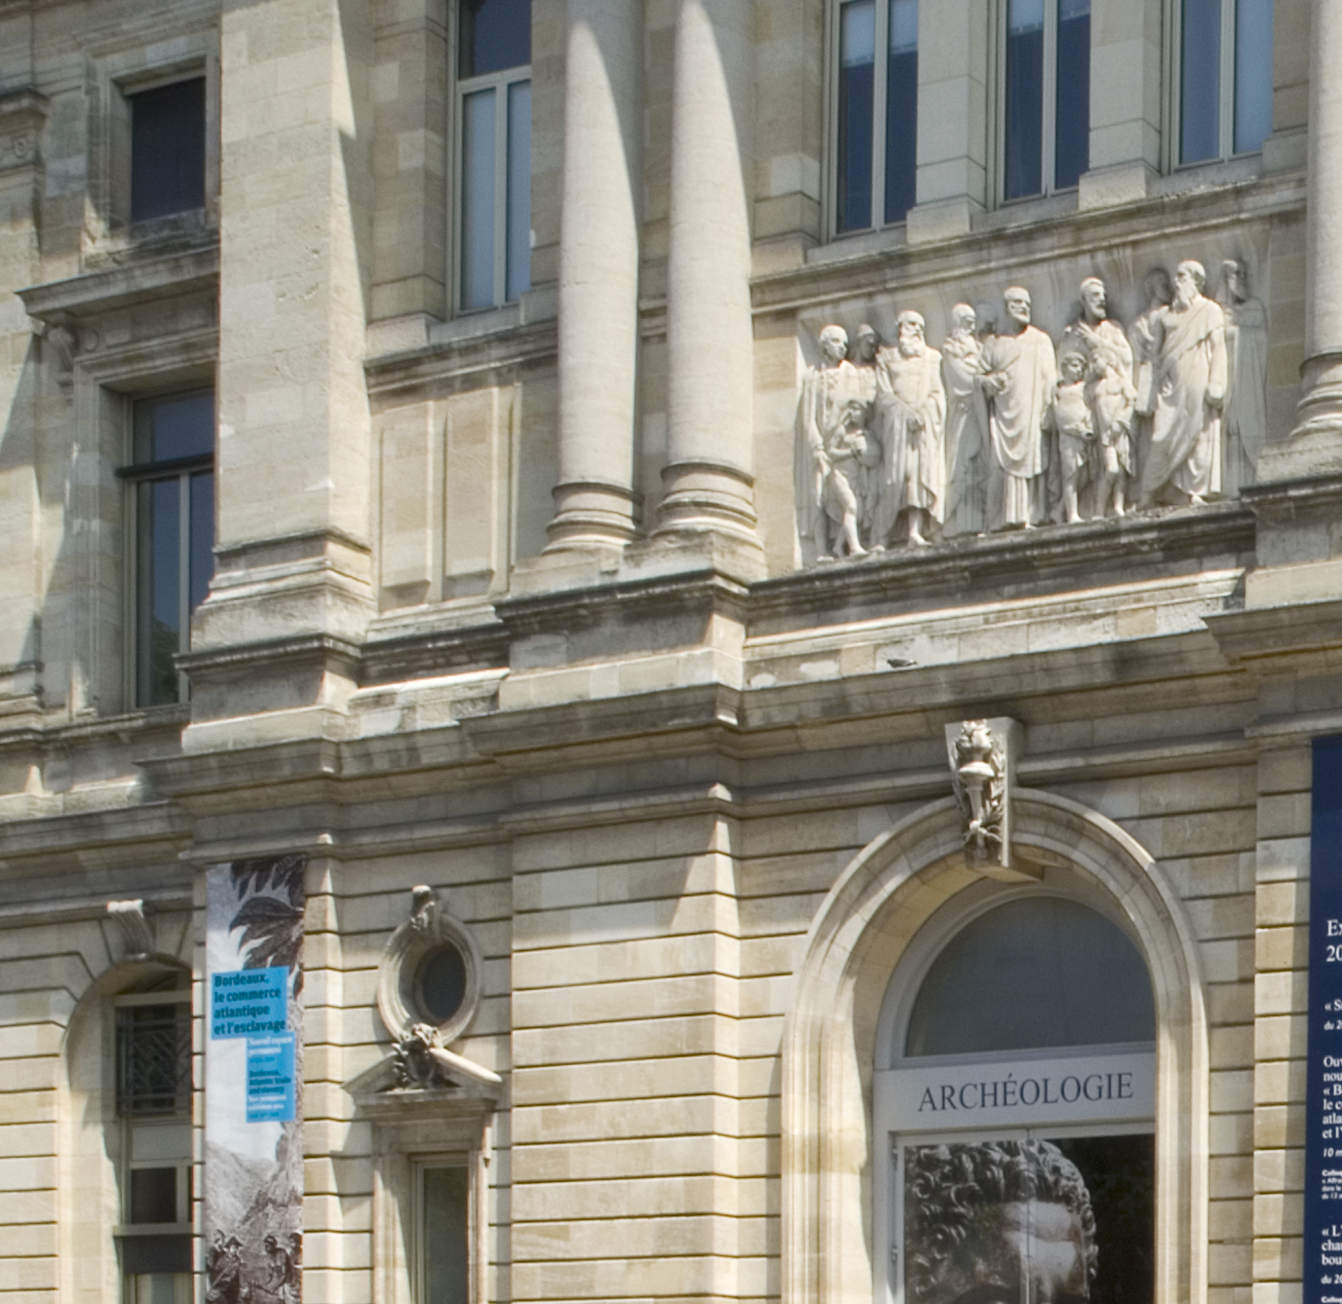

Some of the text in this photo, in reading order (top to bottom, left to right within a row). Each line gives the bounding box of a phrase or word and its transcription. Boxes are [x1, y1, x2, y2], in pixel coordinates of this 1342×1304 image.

[214, 973, 269, 988] Bordeaux,
[214, 987, 281, 1003] le commerce
[214, 1005, 270, 1019] atlantique
[214, 1020, 286, 1035] et l'esclavage
[1323, 1021, 1335, 1030] du
[918, 1072, 1134, 1112] ARCHÉOLOGIE
[1323, 1098, 1333, 1110] le
[1322, 1128, 1333, 1139] et
[1323, 1147, 1334, 1158] 10
[1321, 1274, 1332, 1284] du
